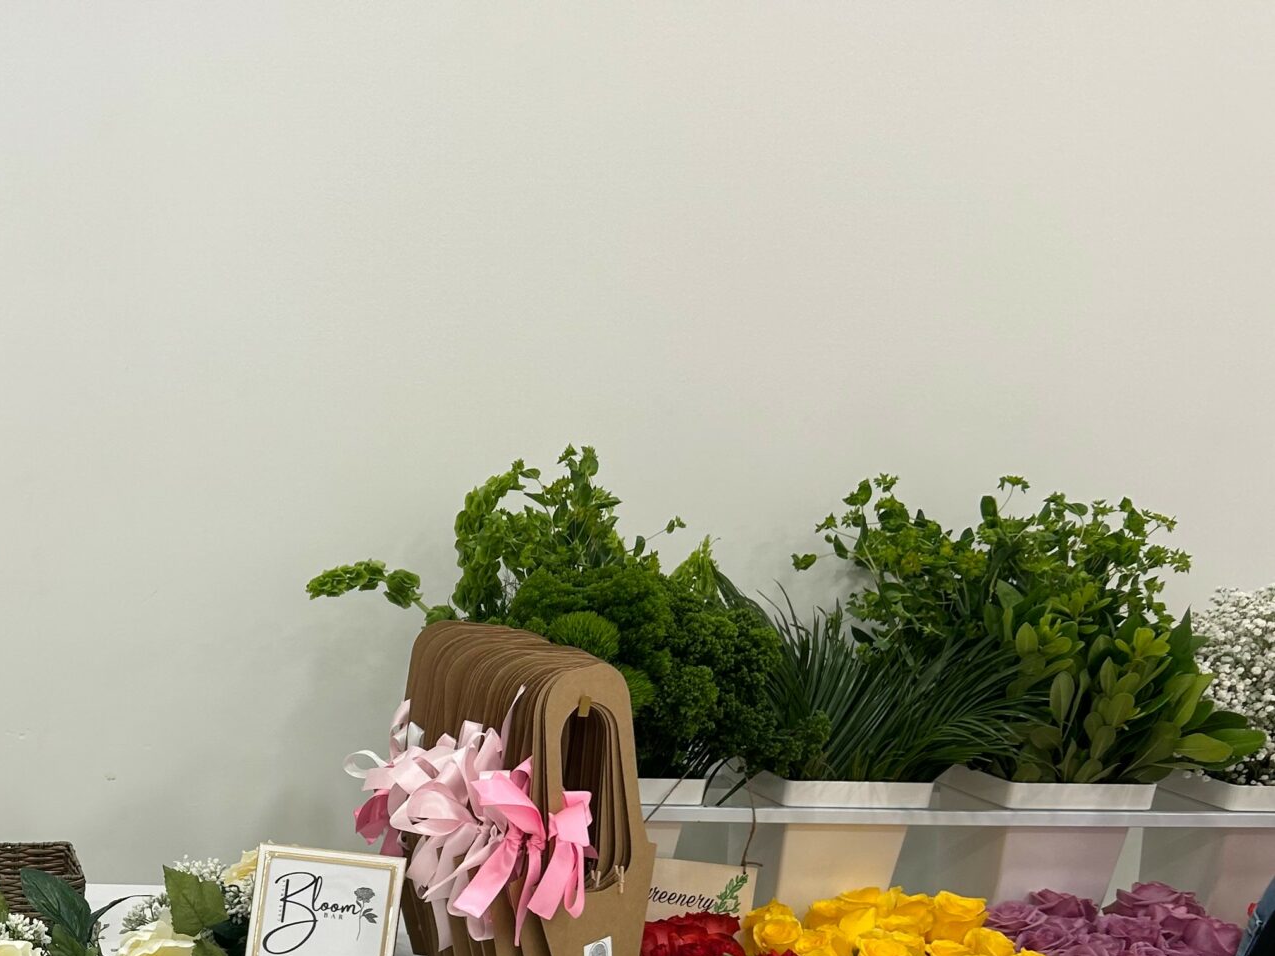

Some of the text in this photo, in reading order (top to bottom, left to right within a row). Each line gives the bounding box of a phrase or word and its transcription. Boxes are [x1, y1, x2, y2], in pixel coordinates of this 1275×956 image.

[648, 886, 715, 912] reenery
[262, 871, 358, 955] Bloom
[323, 912, 344, 920] BAR
